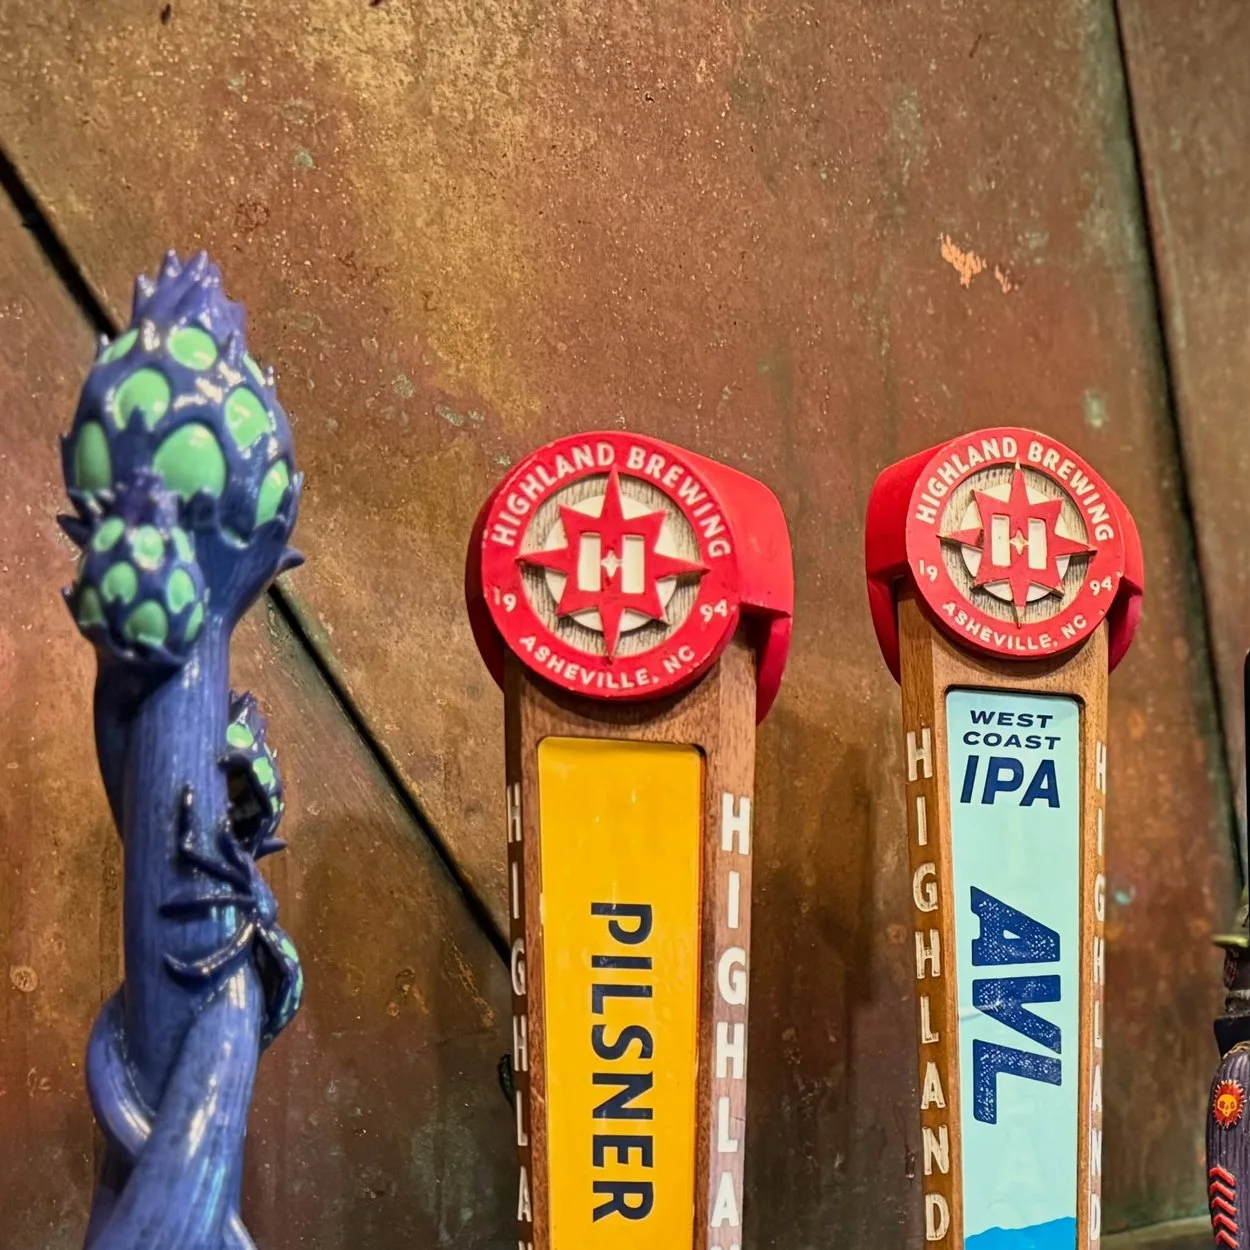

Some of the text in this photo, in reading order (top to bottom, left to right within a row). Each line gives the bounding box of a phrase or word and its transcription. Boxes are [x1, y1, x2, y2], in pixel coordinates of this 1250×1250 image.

[491, 443, 731, 558] HIGHLAND BREWING
[914, 437, 1114, 541] HIGHLAND BREWING
[665, 645, 696, 674] NC
[1063, 614, 1087, 639] NC
[963, 731, 1061, 750] COAST
[970, 710, 1053, 729] WEST
[960, 754, 1061, 809] IPA
[907, 728, 950, 1242] HIGHLAND
[970, 885, 1062, 1125] AVL
[1090, 741, 1107, 1240] HIGHLAND
[591, 902, 654, 1223] PILSNER
